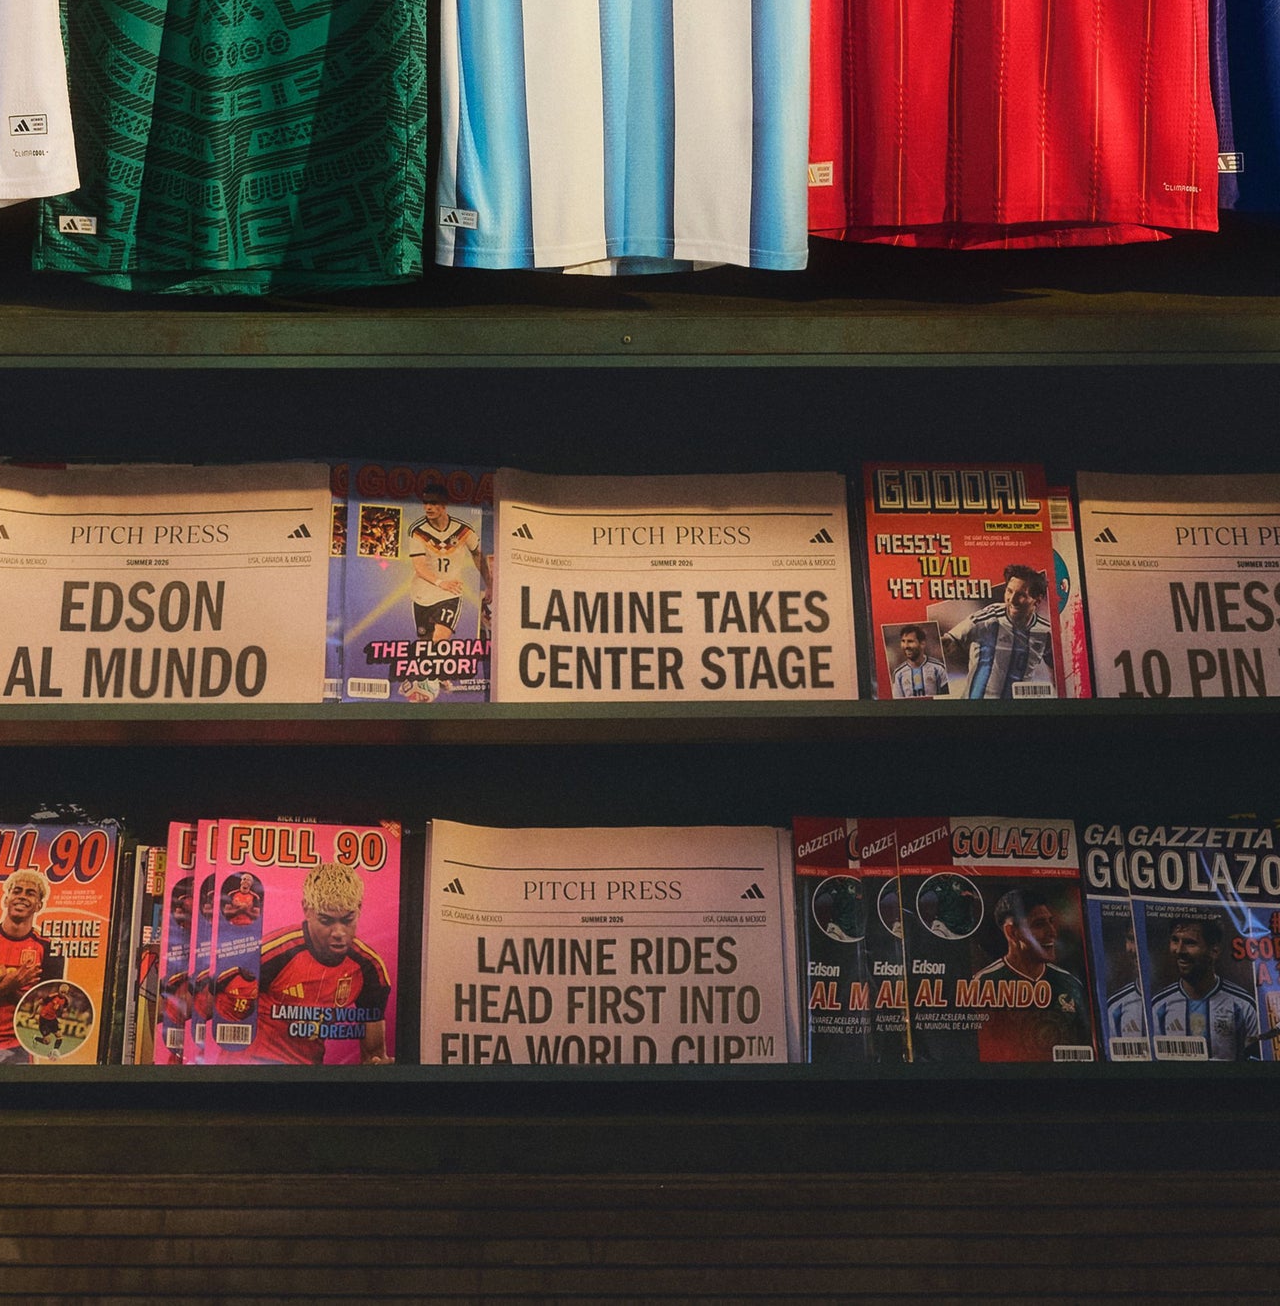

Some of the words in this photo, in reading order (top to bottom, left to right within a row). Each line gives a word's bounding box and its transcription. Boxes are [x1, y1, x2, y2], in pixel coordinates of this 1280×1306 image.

[874, 469, 1042, 514] GOOOAL
[70, 525, 143, 544] PITCH
[154, 524, 229, 544] PRESS
[592, 526, 664, 545] PITCH
[676, 525, 751, 544] PRESS
[876, 533, 952, 554] MESSI'S
[1176, 526, 1247, 545] PITCH
[437, 557, 450, 572] 17
[918, 556, 970, 577] 10/10
[888, 578, 924, 599] YET
[929, 578, 992, 599] AGAIN
[60, 580, 225, 632] EDSON
[440, 608, 454, 624] 17
[520, 585, 683, 634] LAMINE
[697, 589, 831, 634] TAKES
[371, 642, 409, 659] THE
[3, 646, 62, 698] AL
[82, 645, 267, 698] MUNDO
[395, 658, 477, 676] FACTOR!
[519, 641, 684, 690] CENTER
[700, 644, 835, 690] STAGE
[1112, 649, 1171, 698] 10
[1189, 647, 1270, 697] PIN
[229, 825, 319, 868] FULL
[336, 830, 387, 871] 90
[798, 827, 845, 858] GAZZETTA
[900, 825, 948, 858] GAZZETTA
[951, 826, 1070, 858] GOLAZO!
[1128, 824, 1273, 849] GAZZETTA
[45, 828, 110, 884] 90
[523, 881, 595, 900] PITCH
[607, 881, 682, 900] PRESS
[41, 919, 102, 938] CENTRE
[49, 940, 99, 959] STAGE
[477, 936, 616, 976] LAMINE
[630, 936, 738, 975] RIDES
[808, 961, 840, 977] Edson
[912, 959, 946, 975] Edson
[1257, 961, 1273, 986] A
[454, 983, 553, 1024] HEAD
[567, 985, 667, 1024] FIRST
[679, 985, 760, 1024] INTO
[808, 981, 841, 1010] AL
[875, 980, 907, 1009] AL
[914, 979, 949, 1008] AL
[955, 979, 1052, 1009] MANDO
[271, 1005, 333, 1022] LAMINE'S
[335, 1007, 382, 1022] WORLD
[289, 1022, 316, 1037] CUP
[320, 1023, 365, 1038] DREAM
[441, 1033, 518, 1064] FIFA
[526, 1034, 657, 1064] WORLD
